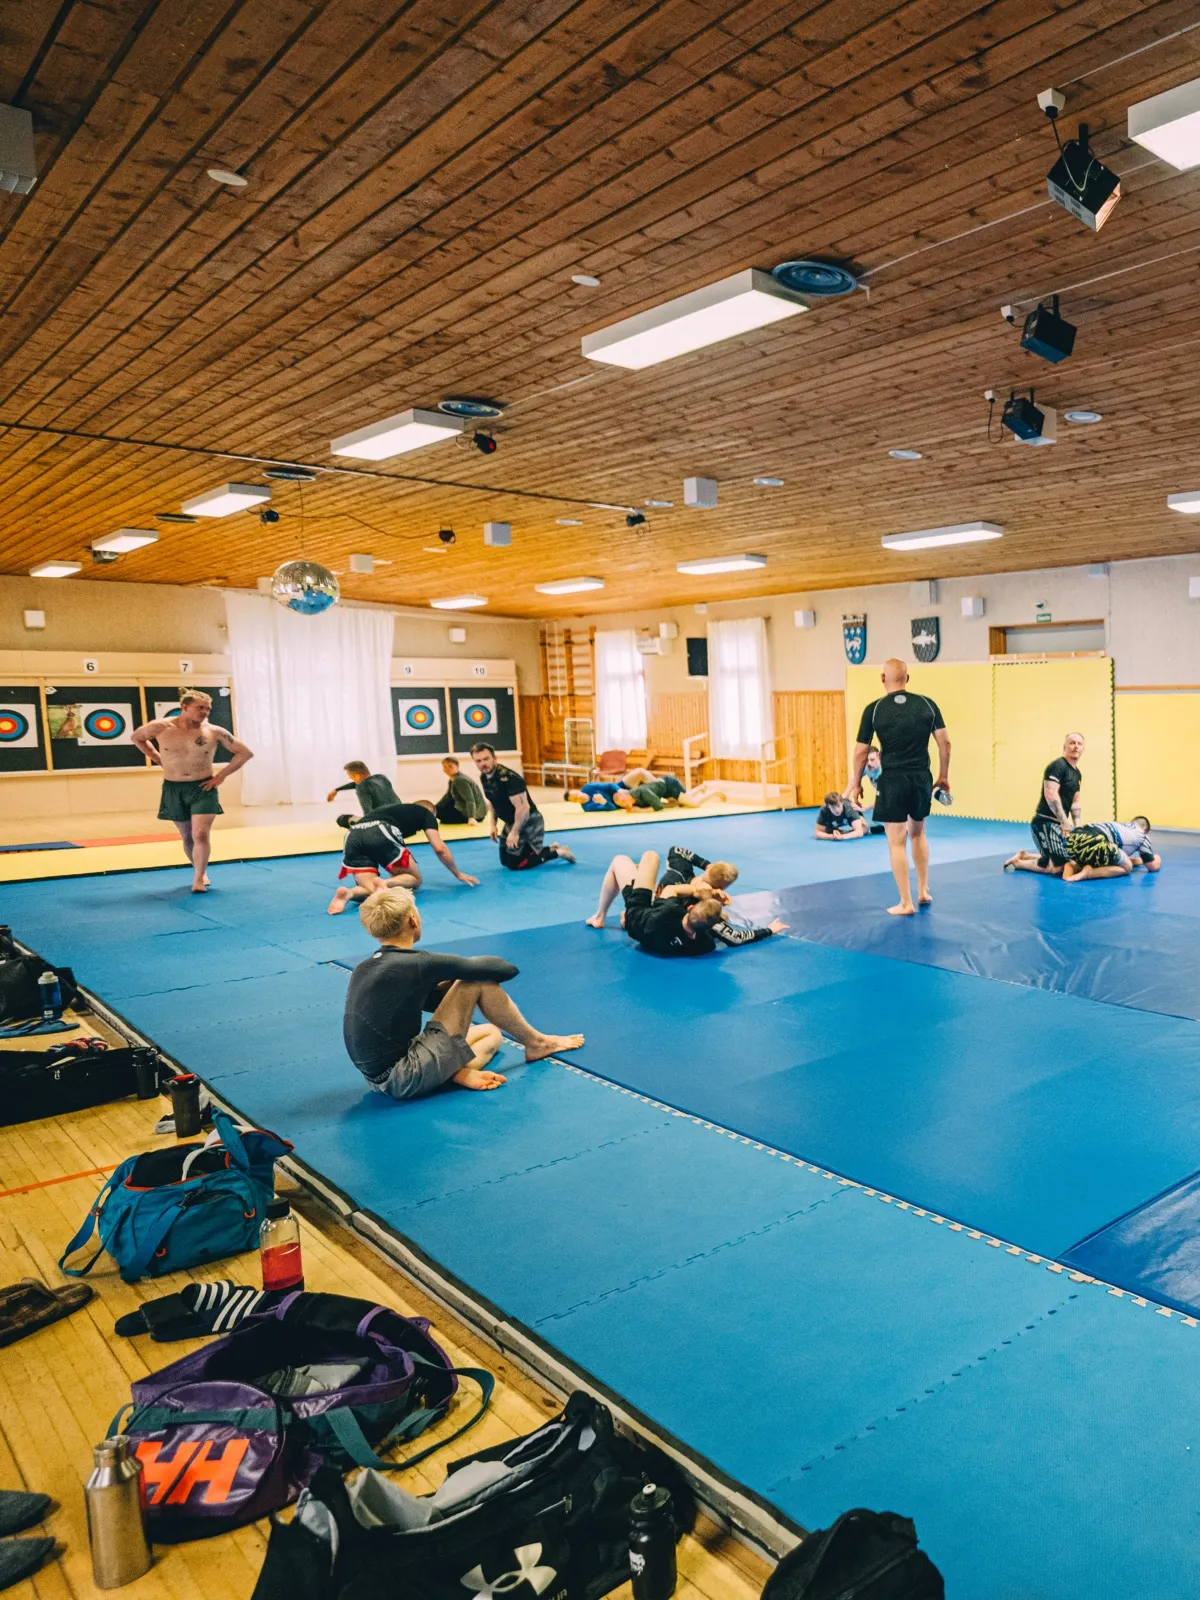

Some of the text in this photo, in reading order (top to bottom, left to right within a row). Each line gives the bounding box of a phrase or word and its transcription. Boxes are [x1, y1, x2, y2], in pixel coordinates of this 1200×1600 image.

[86, 662, 95, 671] 6
[182, 663, 189, 672] 7
[135, 1439, 250, 1505] HH
